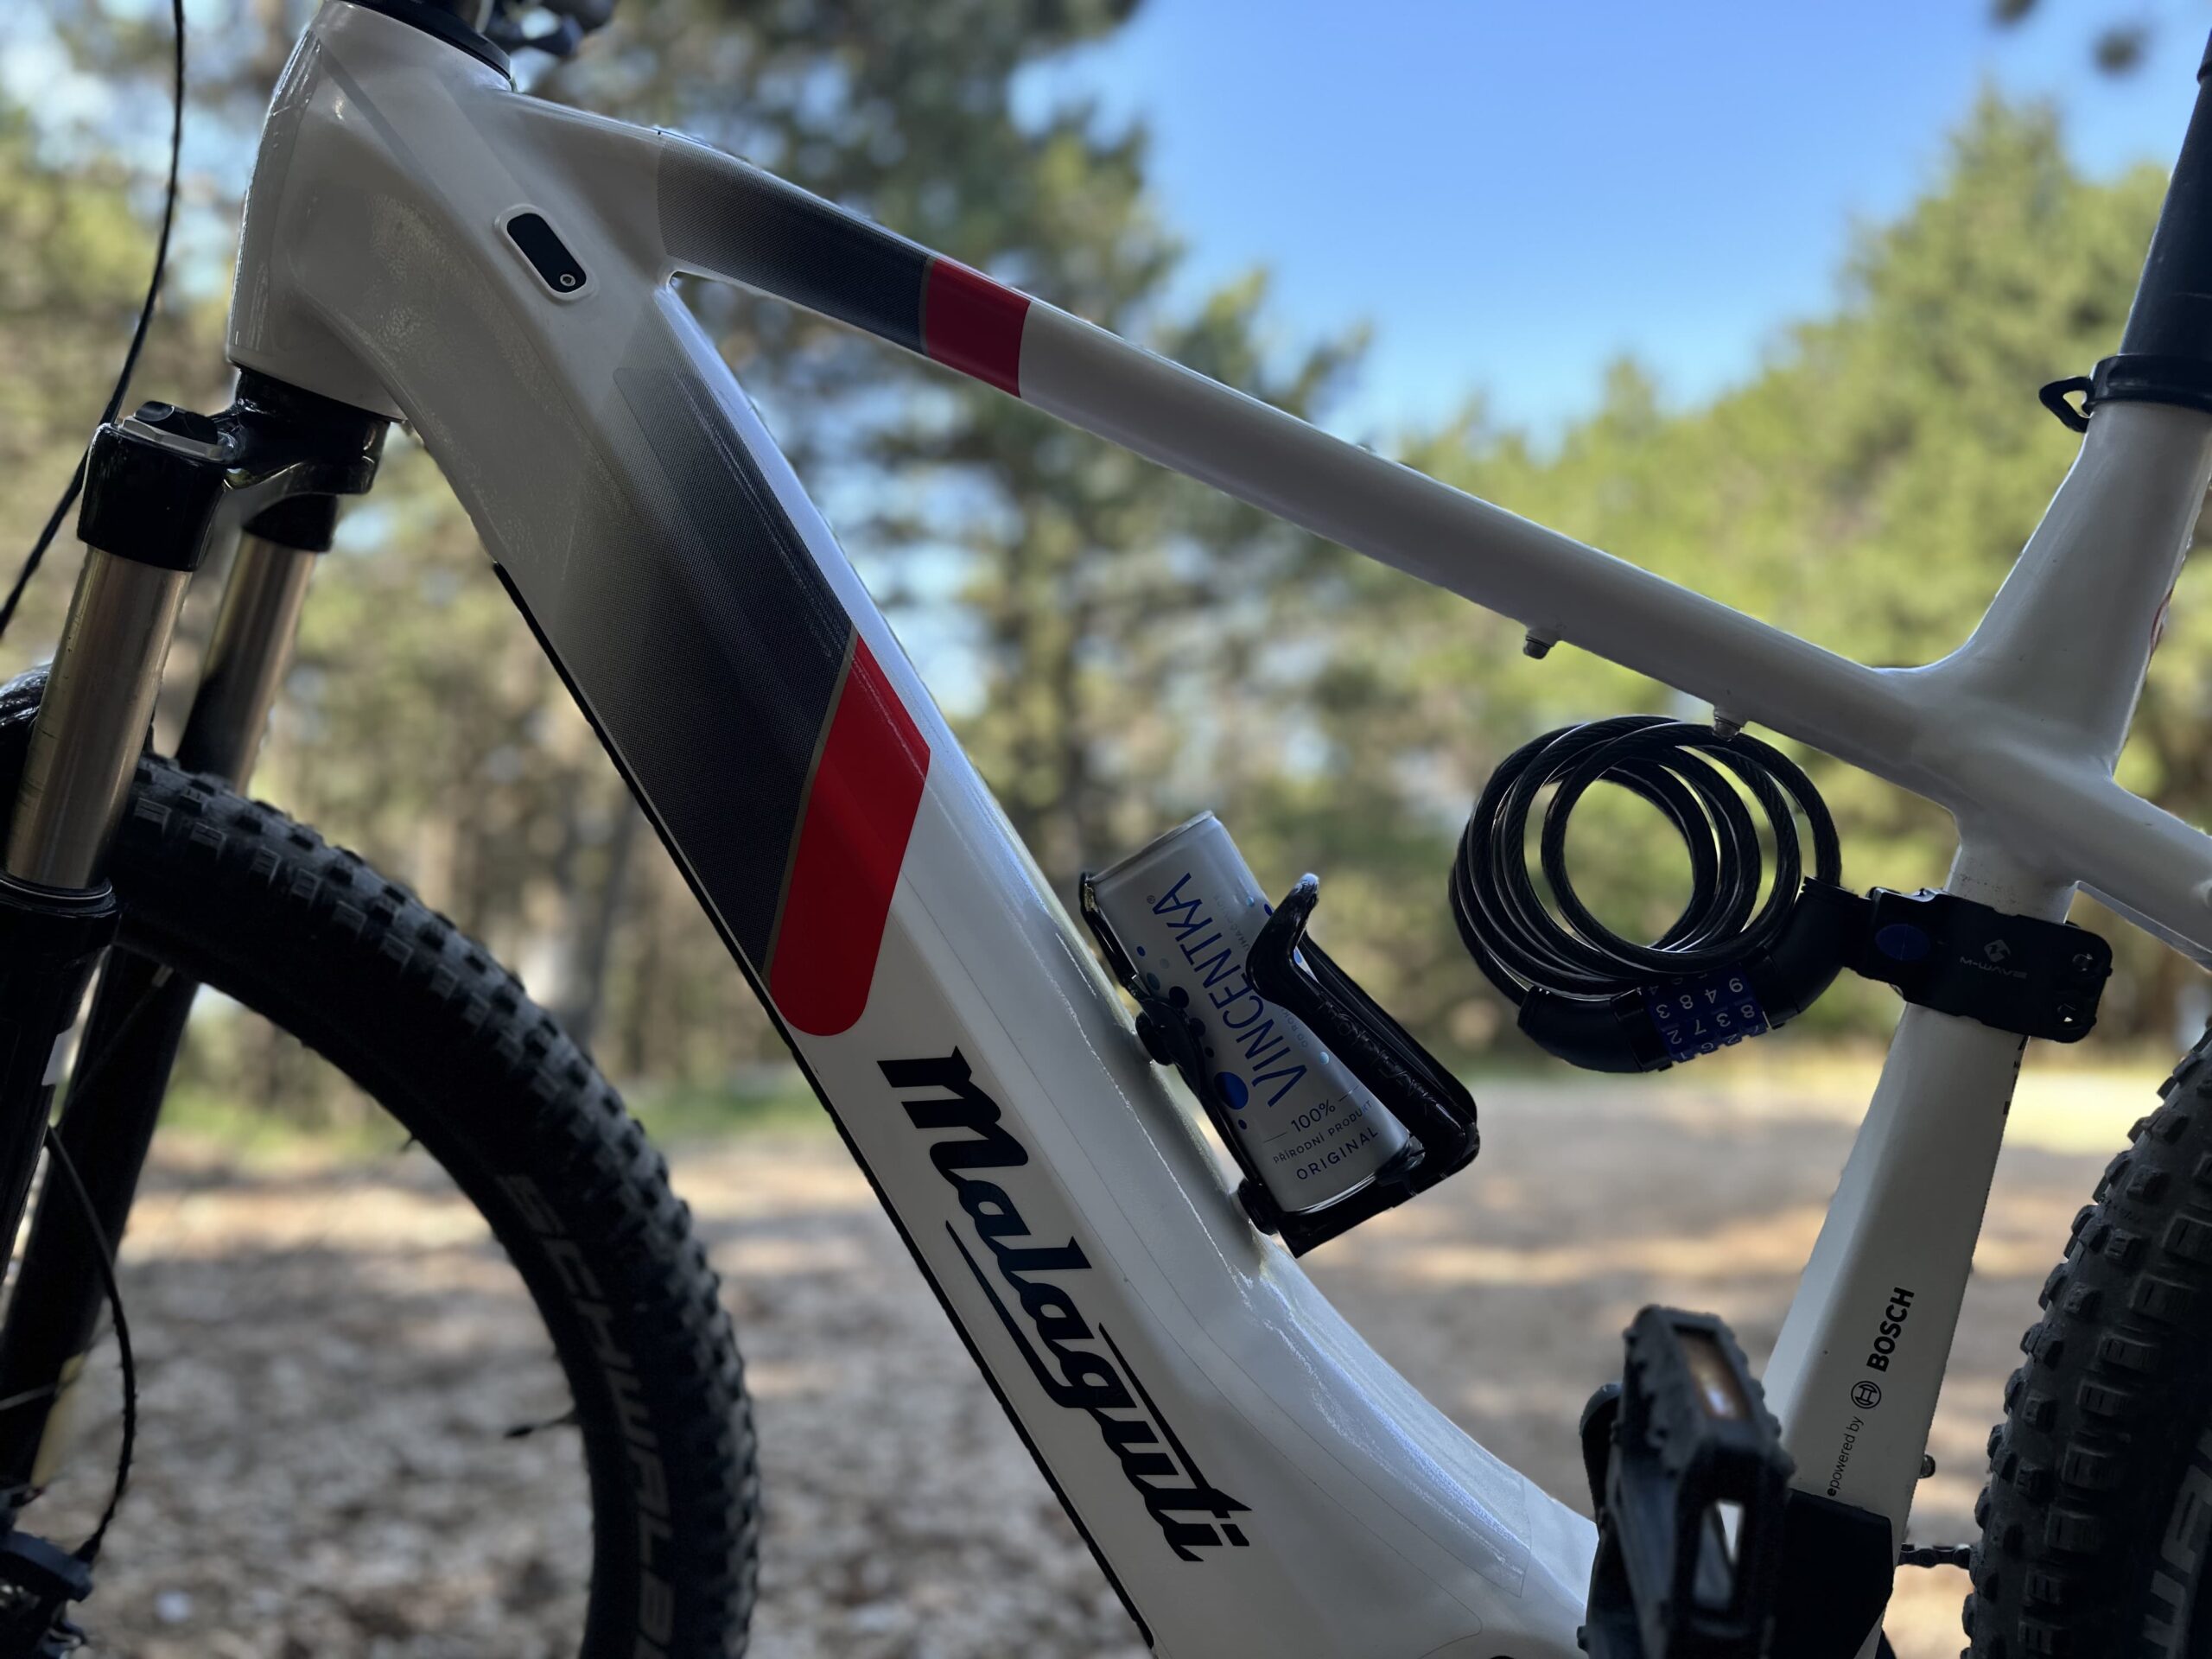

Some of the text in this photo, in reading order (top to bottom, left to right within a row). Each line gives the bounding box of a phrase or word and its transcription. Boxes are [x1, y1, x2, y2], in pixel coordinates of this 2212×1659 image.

[1150, 872, 1308, 1108] VINCENTKA
[1291, 1098, 1336, 1133] 100%
[1328, 1100, 1373, 1137] PRODUKT
[1296, 1127, 1379, 1180] ORIGINAL
[1827, 1287, 1916, 1497] epowered by BOSCH
